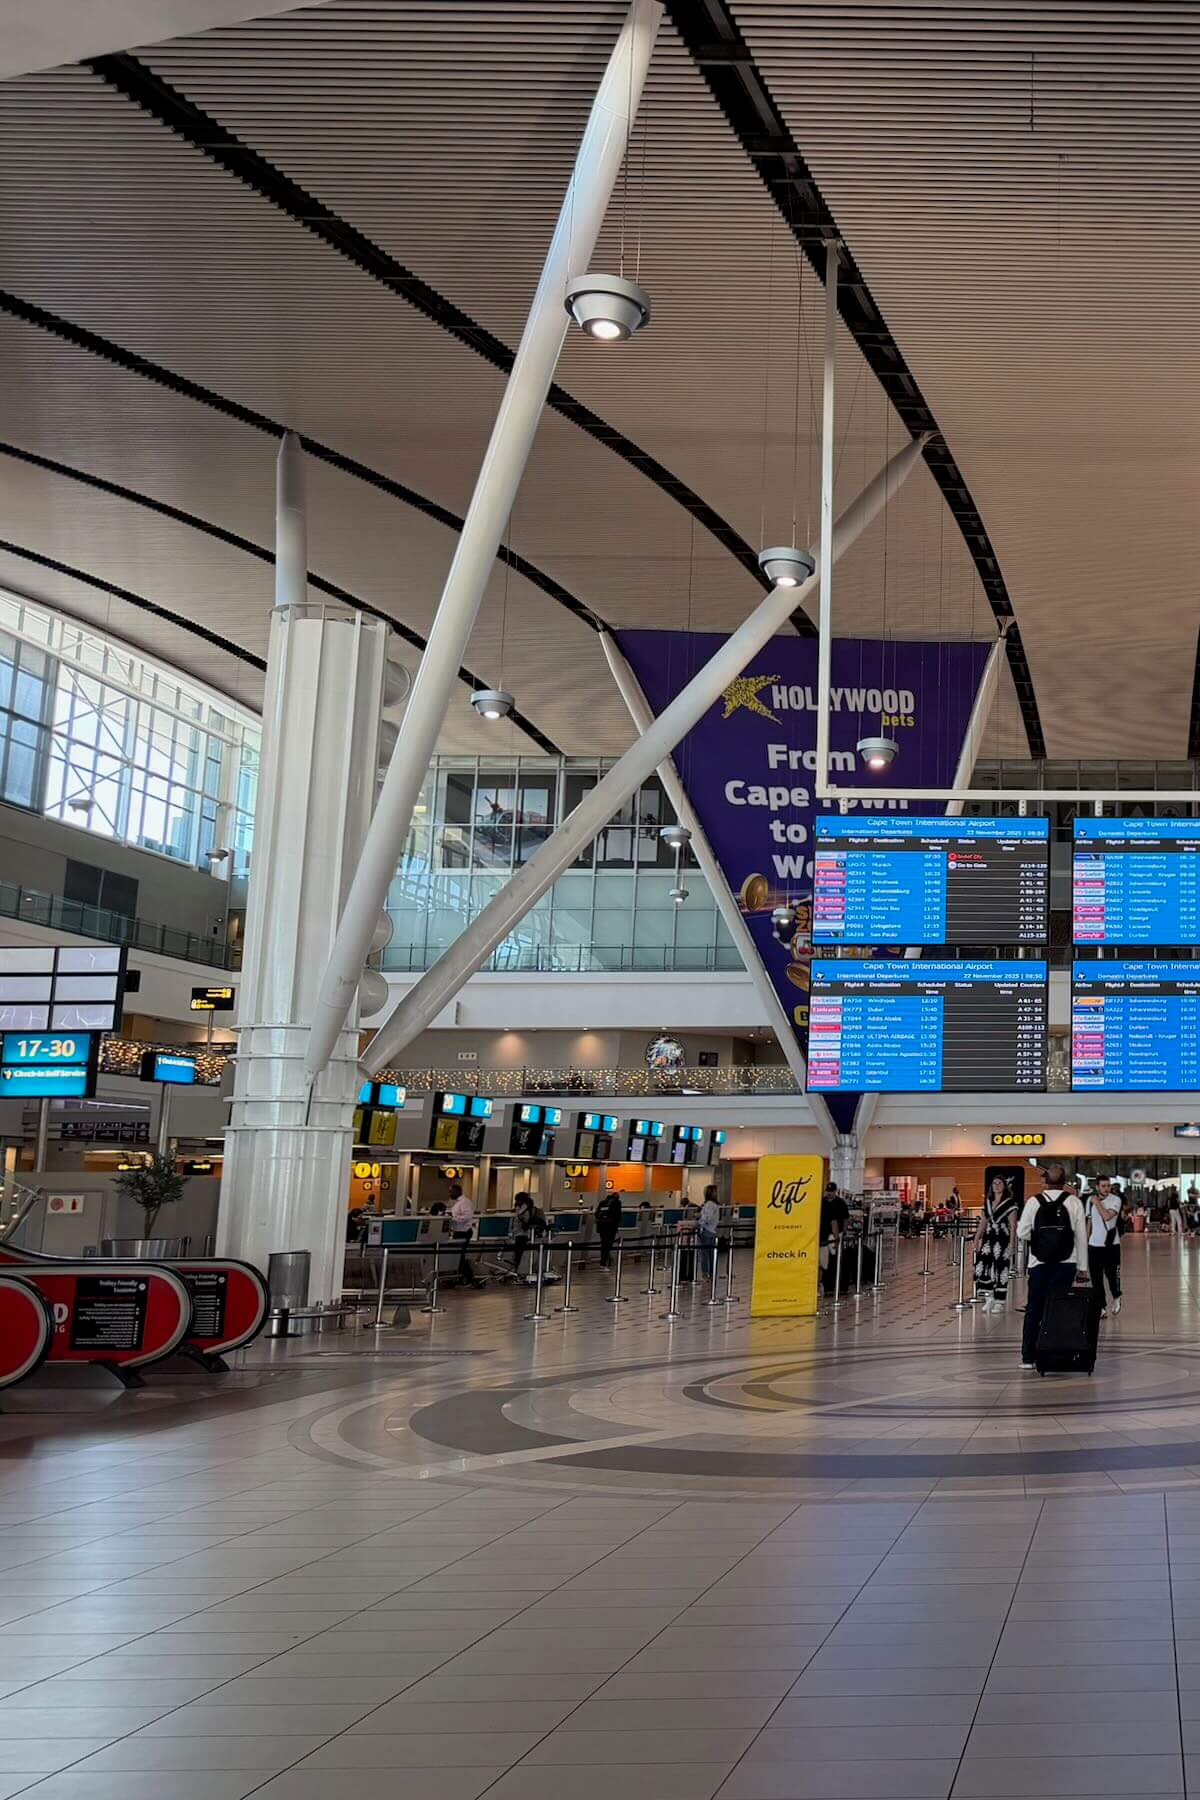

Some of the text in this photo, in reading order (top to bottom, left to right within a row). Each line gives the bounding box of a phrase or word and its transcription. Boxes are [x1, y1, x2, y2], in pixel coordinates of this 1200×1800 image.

[771, 685, 915, 714] HOLYWOOD
[881, 712, 915, 727] bets
[767, 743, 856, 772] From
[724, 780, 810, 811] Cape
[769, 819, 808, 844] to
[867, 819, 888, 827] Cape
[968, 820, 996, 828] Airport
[1123, 821, 1144, 829] Cape
[863, 963, 884, 971] Cape
[965, 963, 993, 971] Airport
[1122, 963, 1144, 971] Cape
[17, 1039, 76, 1057] 17-30
[767, 1175, 813, 1215] lift
[767, 1249, 807, 1259] check in
